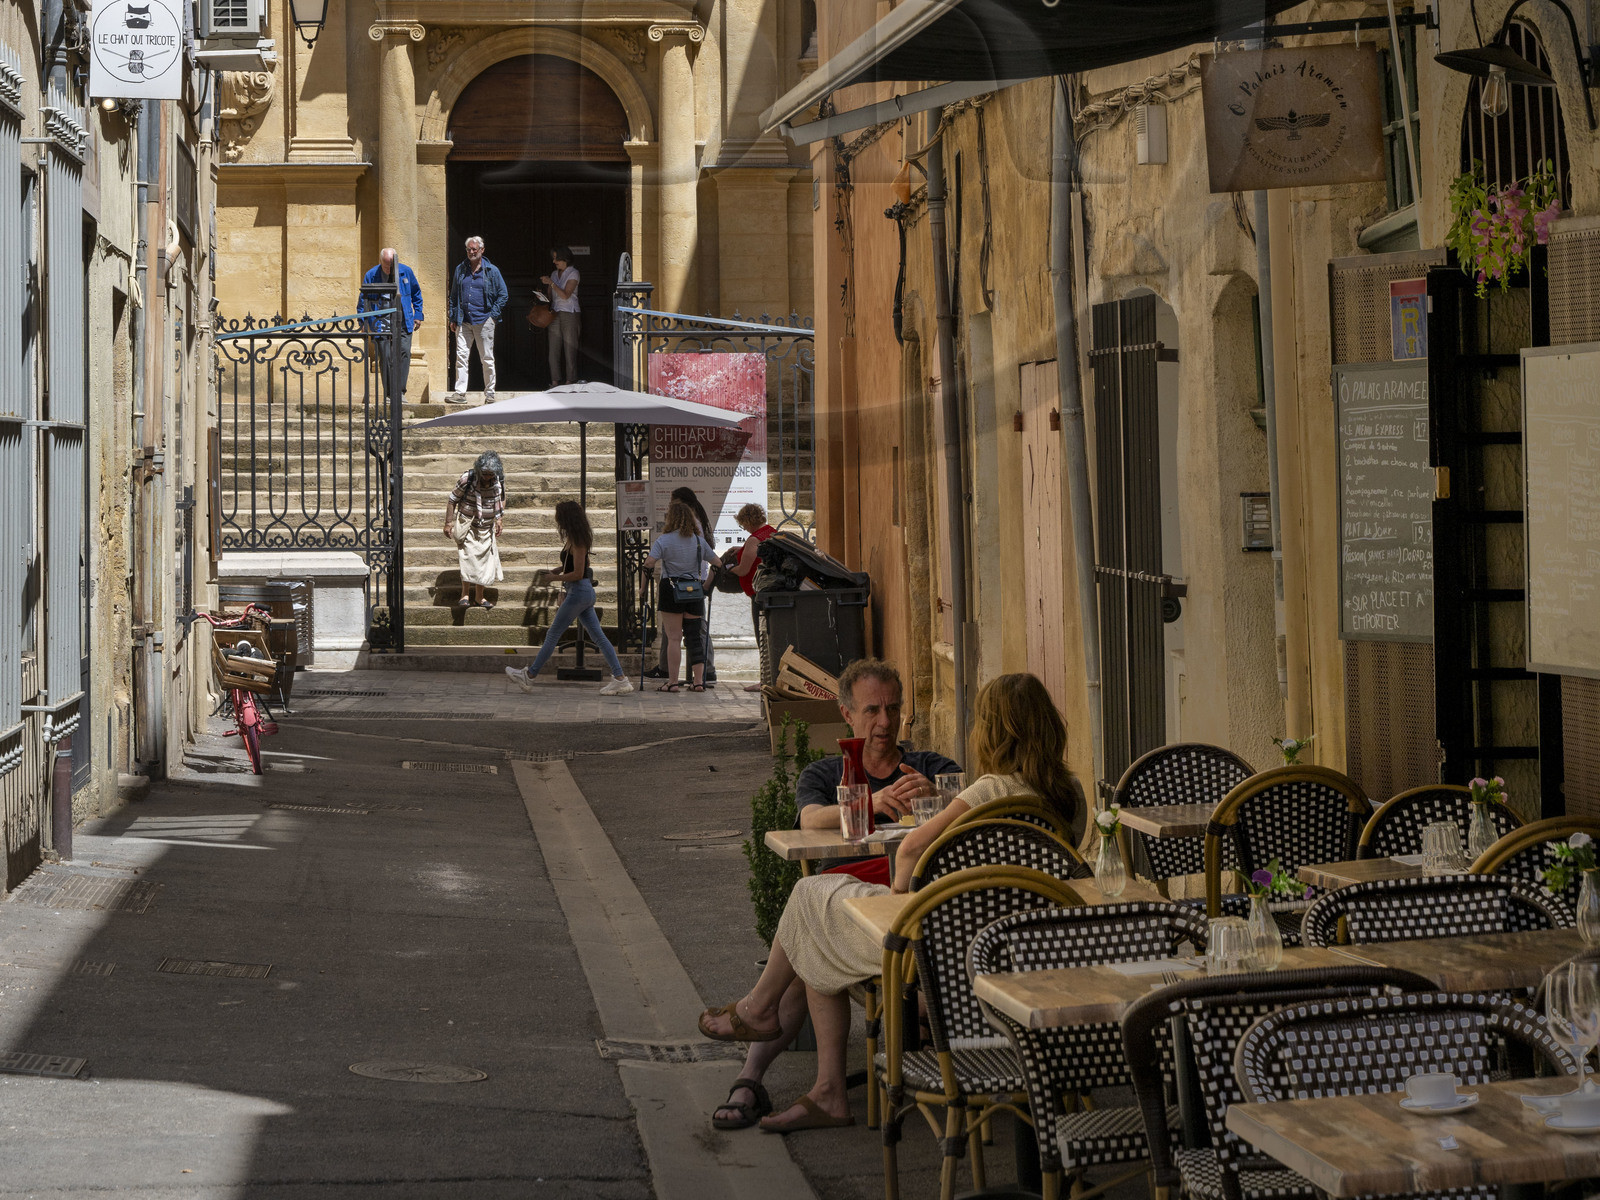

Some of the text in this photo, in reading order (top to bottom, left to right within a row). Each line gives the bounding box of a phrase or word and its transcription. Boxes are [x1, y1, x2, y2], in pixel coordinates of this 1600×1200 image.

[98, 33, 175, 46] LE CHAT QUI TRICOTE
[1239, 64, 1286, 97] Palais
[1266, 147, 1322, 164] RESTAURANT
[1352, 381, 1381, 402] PALAIS
[1383, 380, 1428, 401] ARAMEE
[654, 427, 716, 442] CHIHARU
[1343, 423, 1404, 437] LE MENU EXPRESS
[654, 444, 705, 459] SHIOTA
[655, 466, 762, 478] BEYOND CONSCIOUSNESS
[1344, 521, 1361, 538] PLAT
[1352, 594, 1368, 612] SUR
[1369, 590, 1397, 610] PLACE
[1399, 590, 1412, 608] ET
[1352, 612, 1400, 631] EMPORTER
